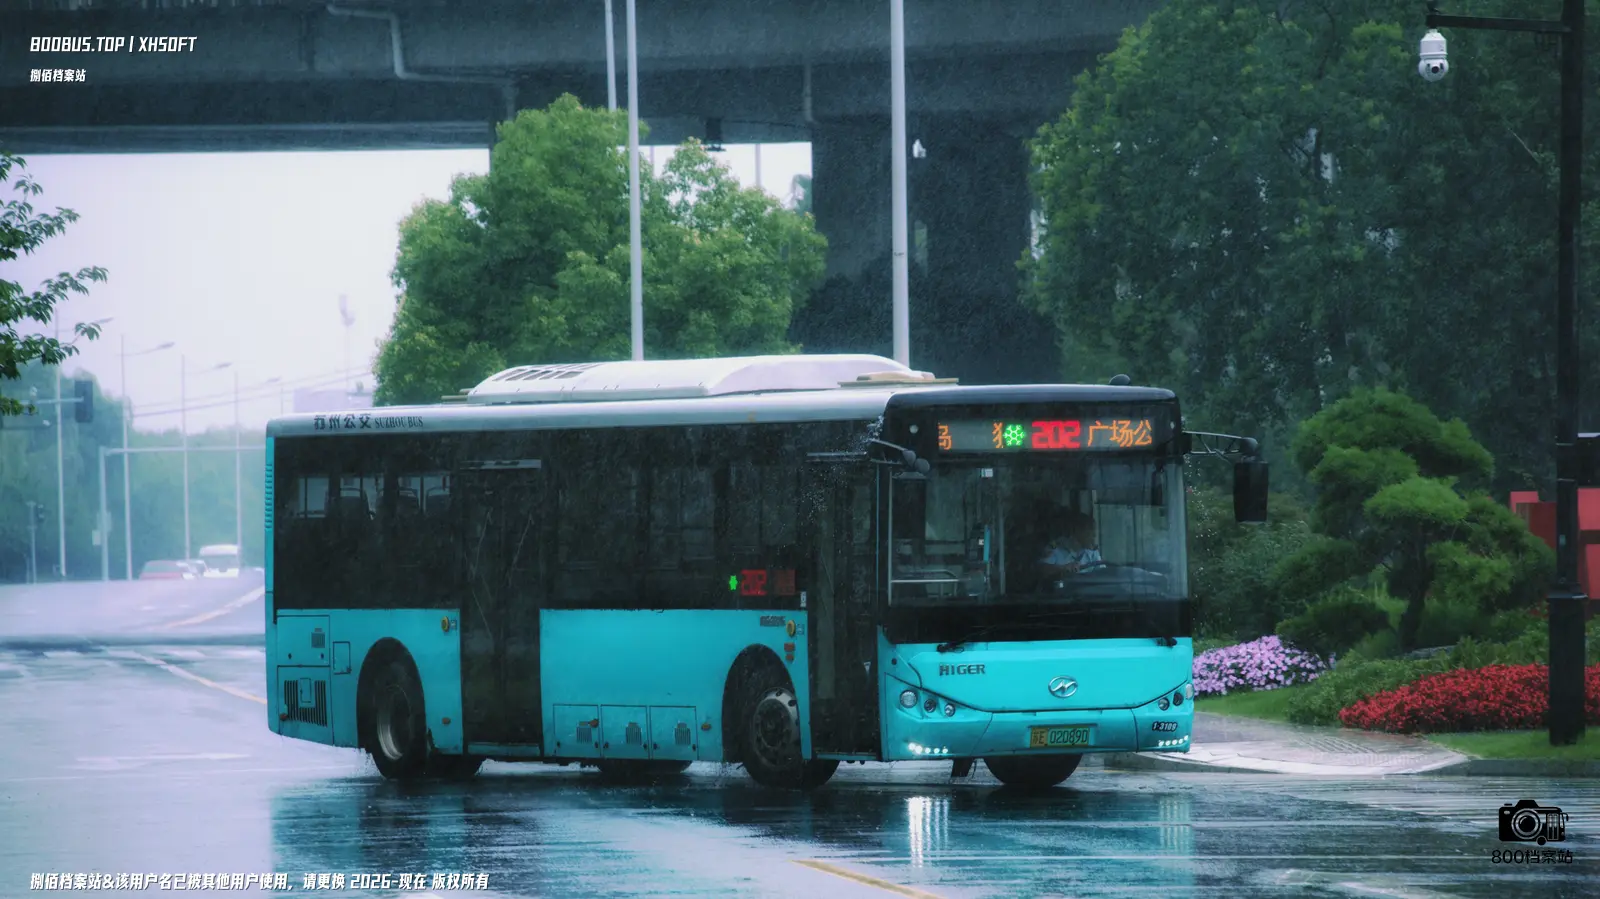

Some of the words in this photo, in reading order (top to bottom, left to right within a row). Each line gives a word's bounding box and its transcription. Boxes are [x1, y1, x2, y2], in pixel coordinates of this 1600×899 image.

[374, 416, 405, 429] SUZHOU
[407, 416, 424, 428] BUS
[1031, 421, 1080, 448] 202
[1086, 420, 1152, 447] 广场公
[939, 663, 986, 676] HIGER
